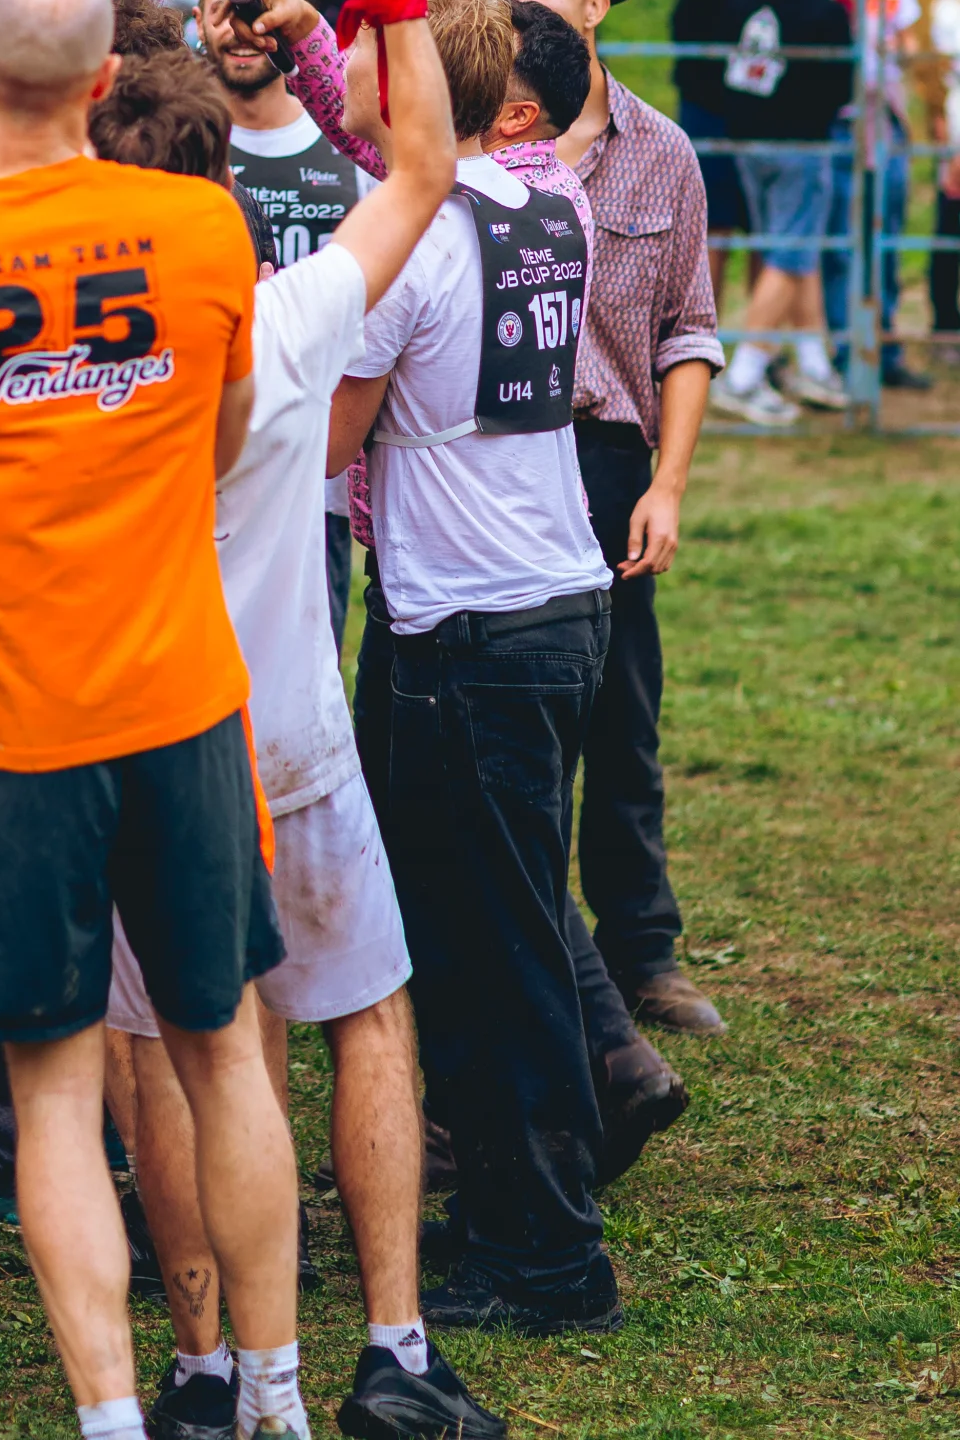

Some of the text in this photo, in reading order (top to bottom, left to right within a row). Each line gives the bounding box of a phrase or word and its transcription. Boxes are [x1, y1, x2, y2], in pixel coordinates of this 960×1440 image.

[288, 203, 345, 219] 2022
[491, 223, 511, 235] ESF
[540, 218, 569, 236] Valloire
[73, 239, 153, 263] TEAM
[519, 247, 556, 266] 11ÈME
[496, 260, 583, 290] JB CUP 2022
[527, 290, 568, 350] 157
[500, 380, 533, 402] U14
